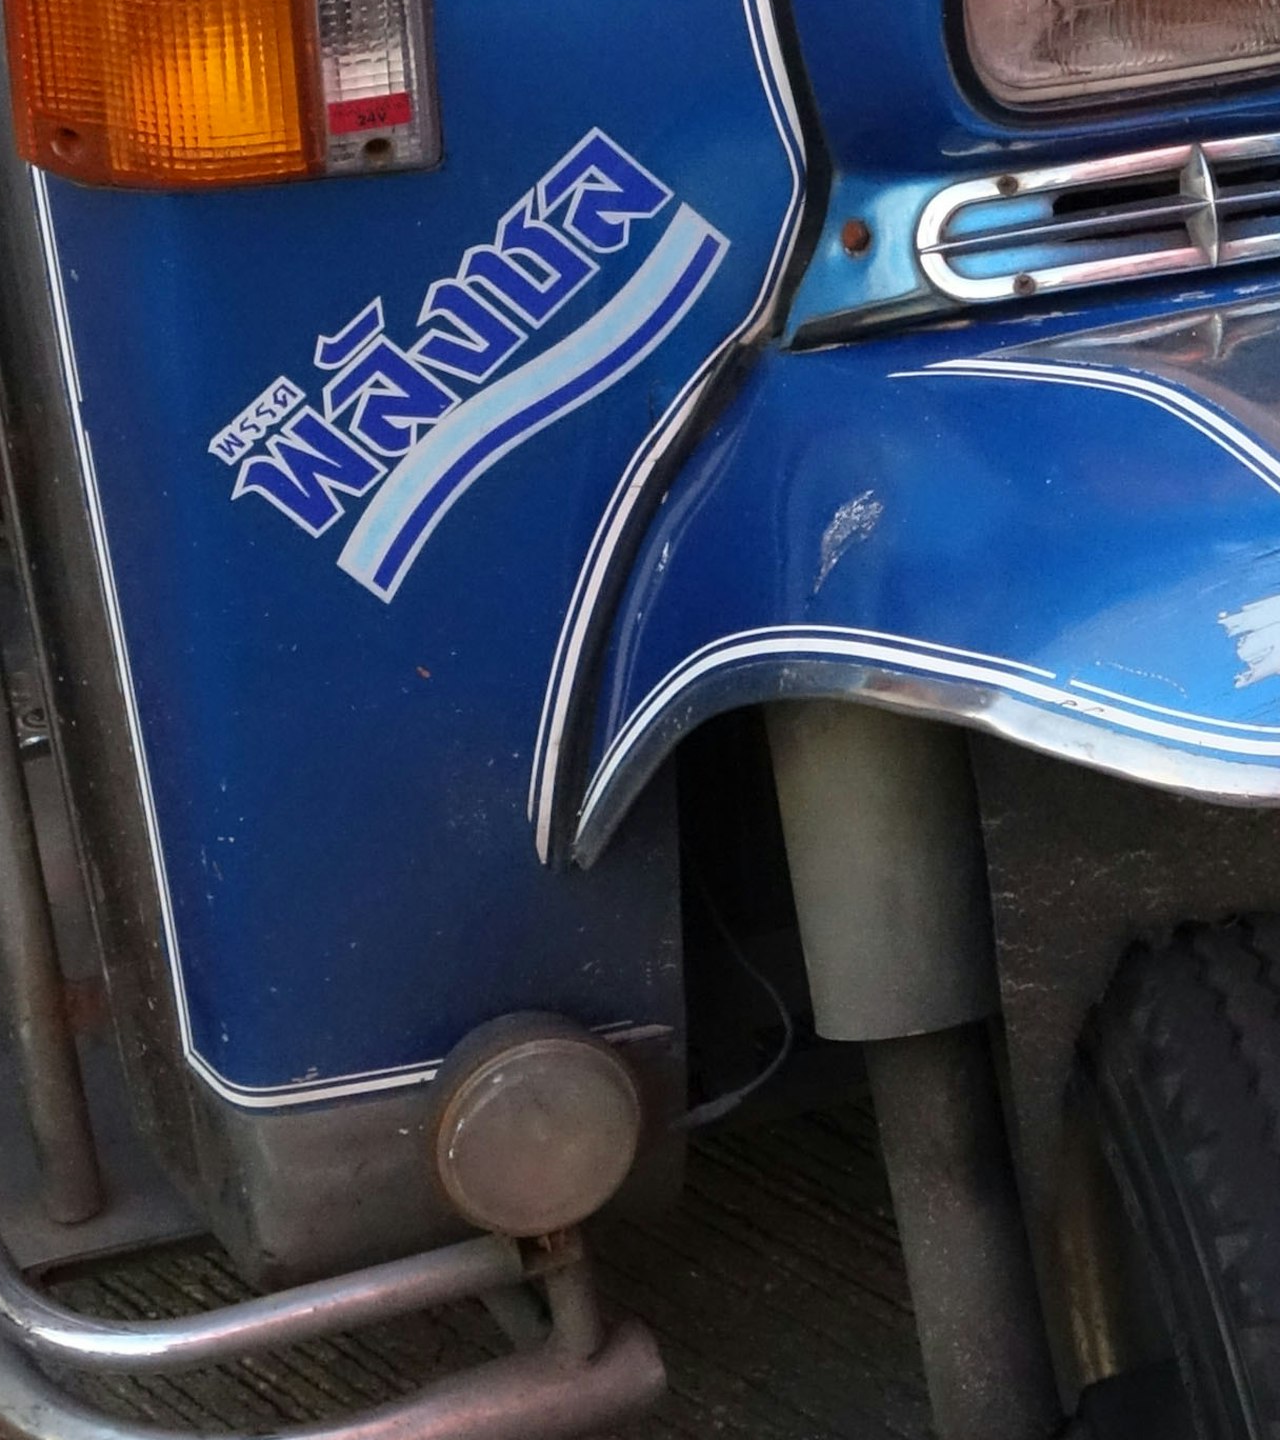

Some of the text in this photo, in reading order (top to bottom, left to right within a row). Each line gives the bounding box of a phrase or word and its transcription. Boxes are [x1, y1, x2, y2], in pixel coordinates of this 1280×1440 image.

[211, 377, 305, 464] พรรค
[232, 126, 674, 538] พลังชล
